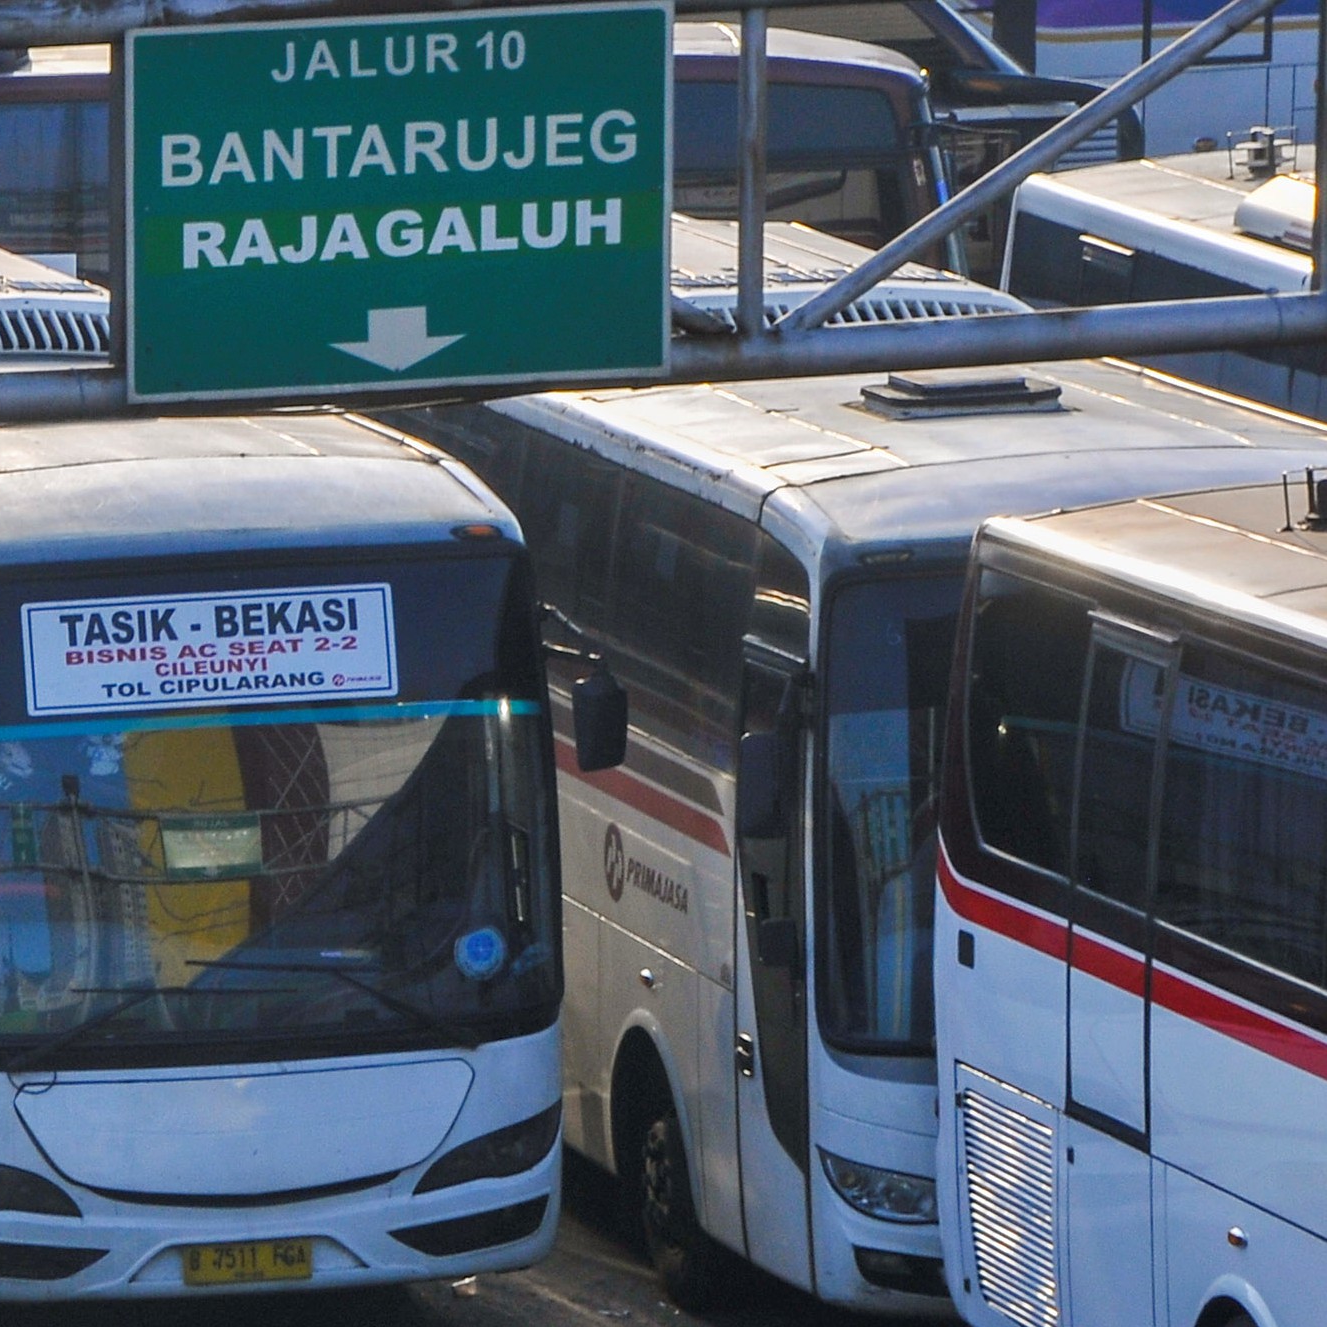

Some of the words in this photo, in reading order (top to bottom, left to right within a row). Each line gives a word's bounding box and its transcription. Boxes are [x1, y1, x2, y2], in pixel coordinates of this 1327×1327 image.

[271, 32, 458, 82] JALUR
[476, 30, 526, 70] 10
[161, 109, 637, 187] BANTARUJEG
[182, 198, 622, 269] RAJAGALUH
[58, 607, 179, 647] TASIK
[190, 623, 202, 632] -
[214, 597, 358, 639] BEKASI
[65, 646, 168, 666] BISNIS
[177, 643, 217, 659] AC
[228, 638, 304, 656] SEAT
[314, 635, 358, 652] 2-2
[154, 657, 268, 678] CILEUNYI
[101, 681, 151, 698] TOL
[159, 671, 325, 695] CIPULARANG
[627, 857, 688, 914] PRIMAJASA
